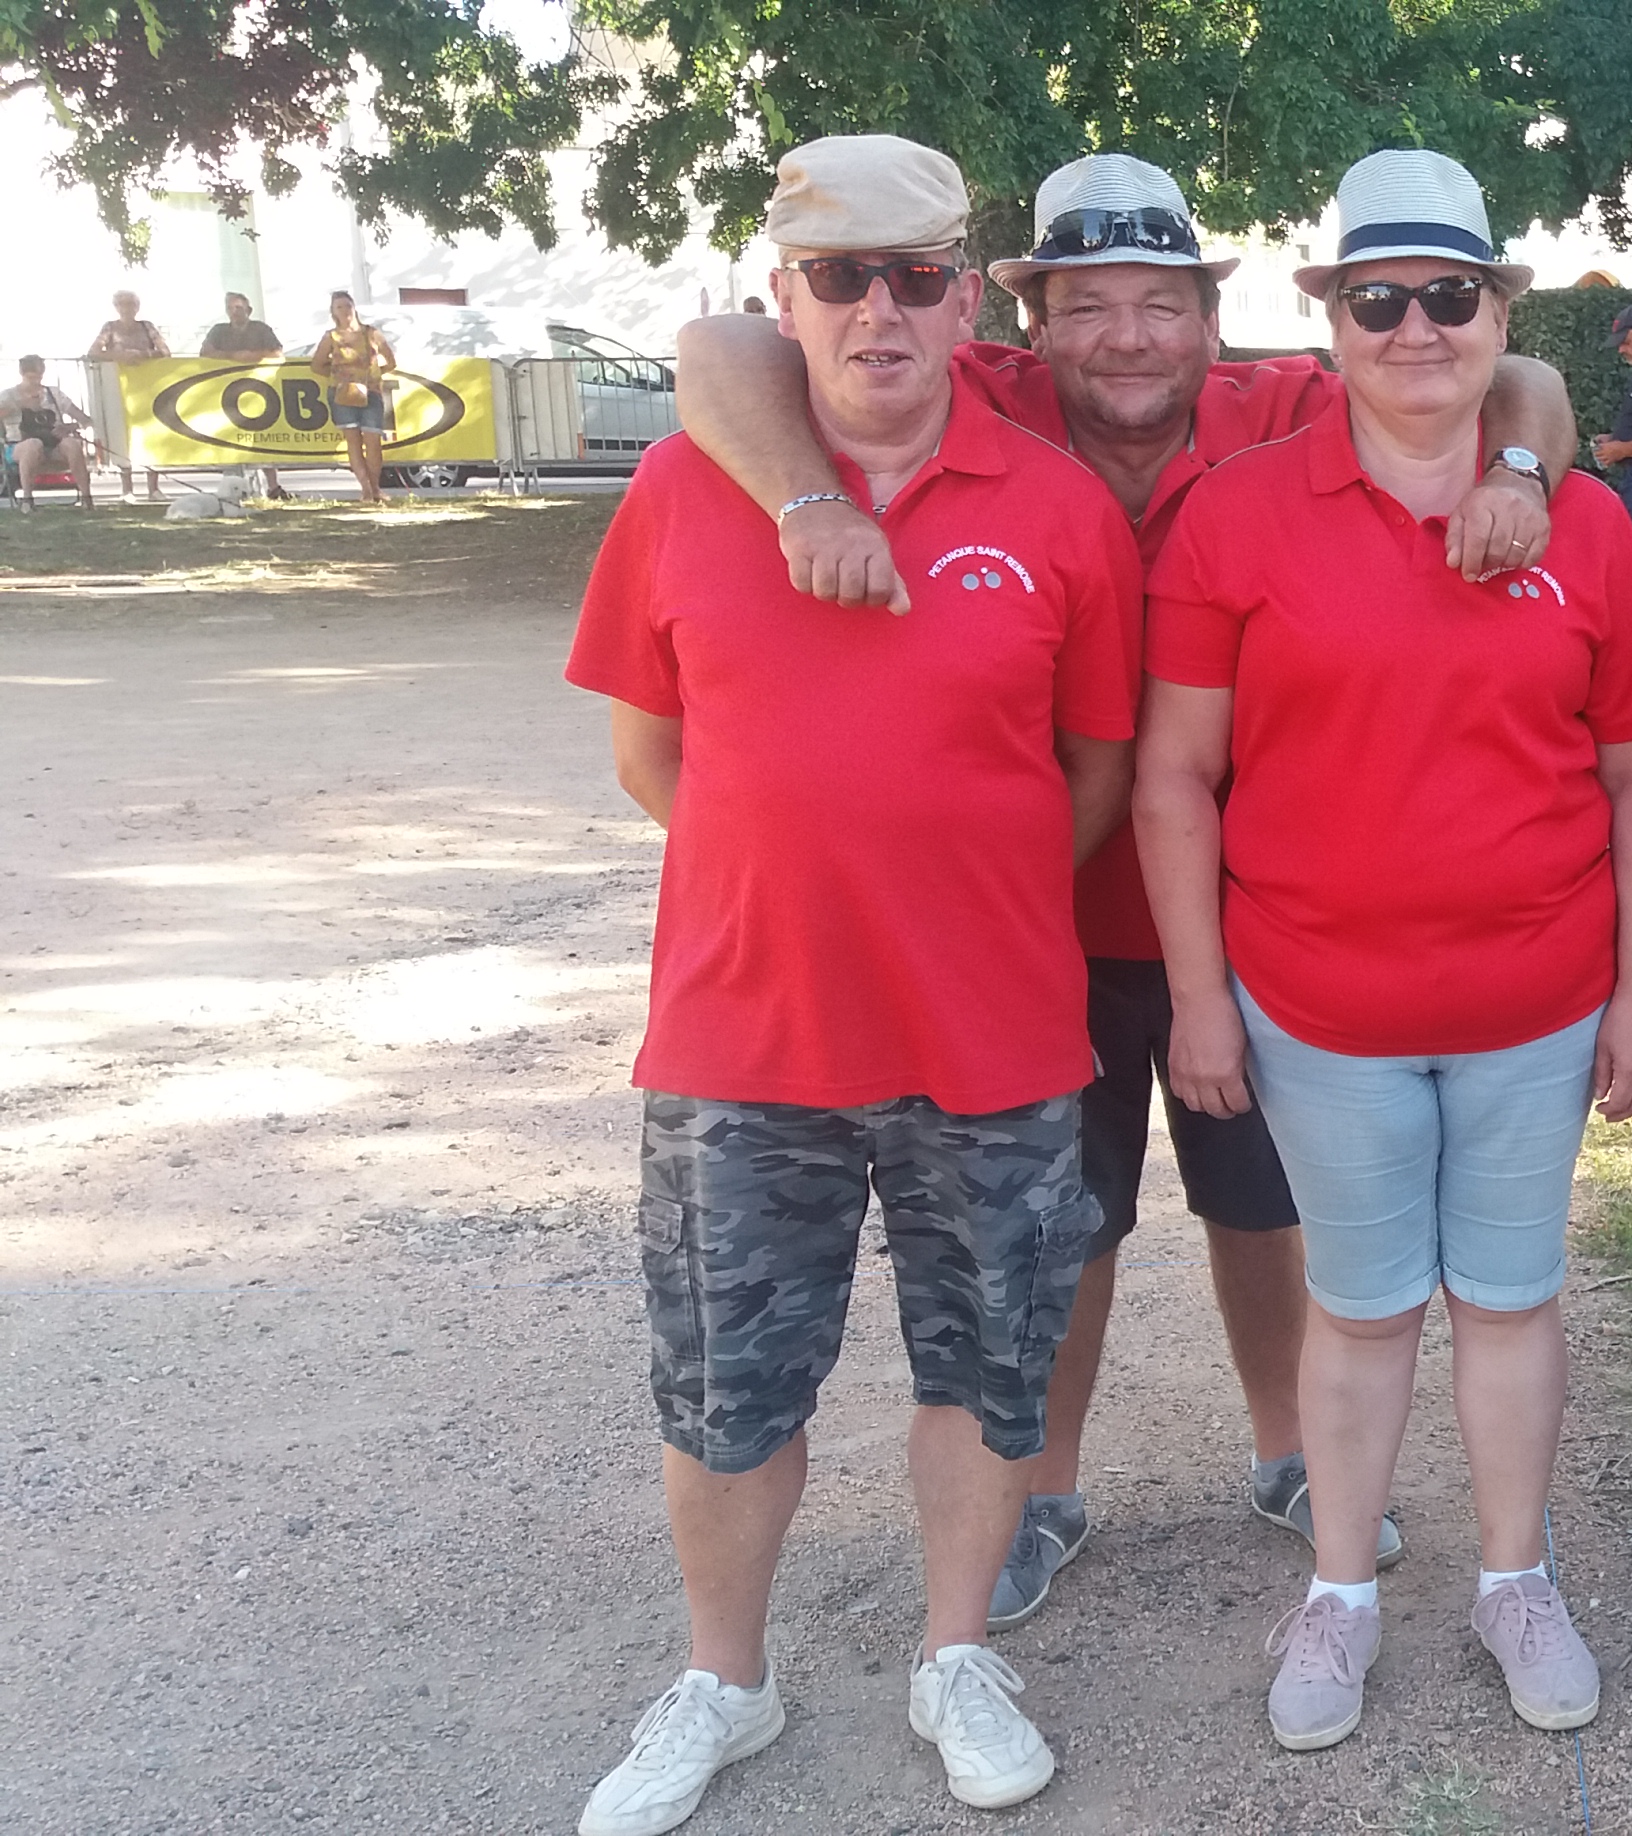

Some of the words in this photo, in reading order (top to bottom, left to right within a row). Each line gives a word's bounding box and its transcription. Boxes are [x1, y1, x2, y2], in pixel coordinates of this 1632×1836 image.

[221, 377, 400, 432] OBT
[237, 433, 291, 443] PREMIER
[294, 433, 311, 443] EN
[928, 546, 975, 579] PETANQUE
[976, 545, 1006, 560] SAINT
[1004, 555, 1036, 594] REMOISE
